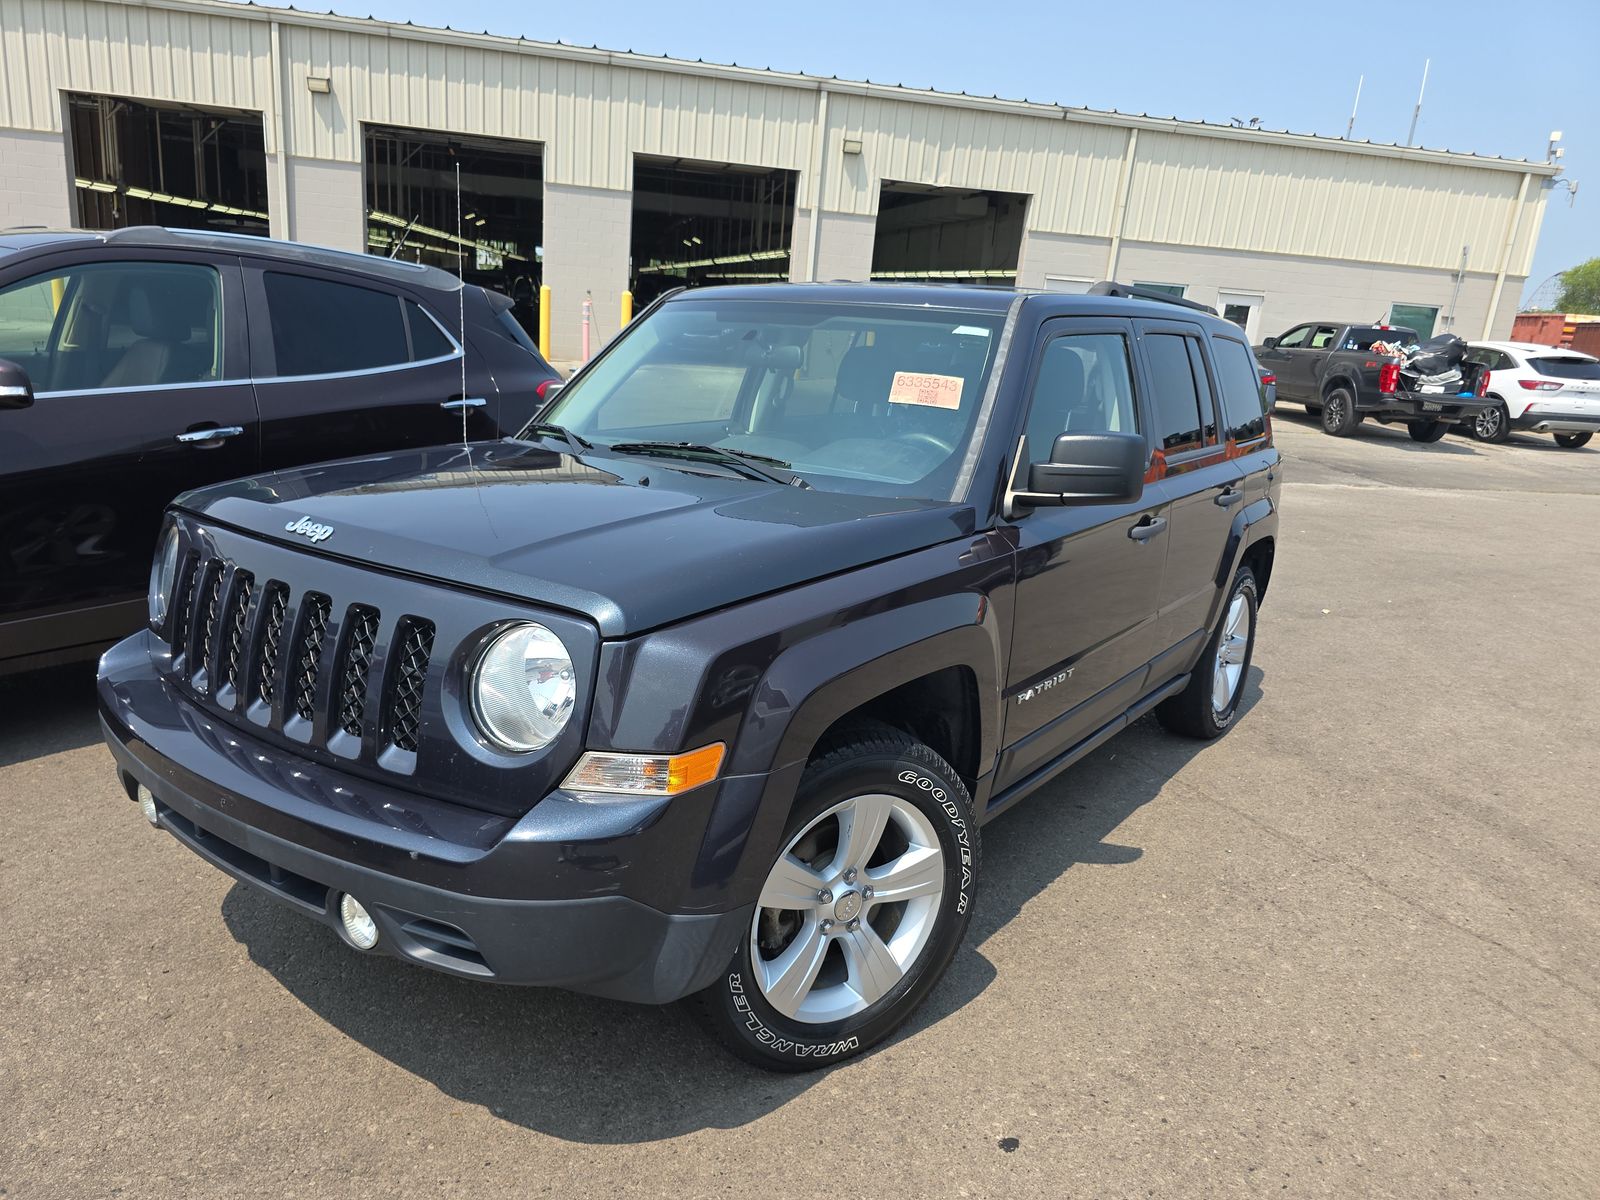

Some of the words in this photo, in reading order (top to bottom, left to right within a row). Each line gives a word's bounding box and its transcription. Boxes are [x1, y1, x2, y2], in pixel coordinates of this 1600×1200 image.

[896, 375, 957, 392] 6335543
[284, 515, 335, 543] Jeep
[1016, 667, 1076, 705] PATRIOT
[898, 770, 972, 915] GOODYEAR
[728, 972, 859, 1057] WRANGLER
